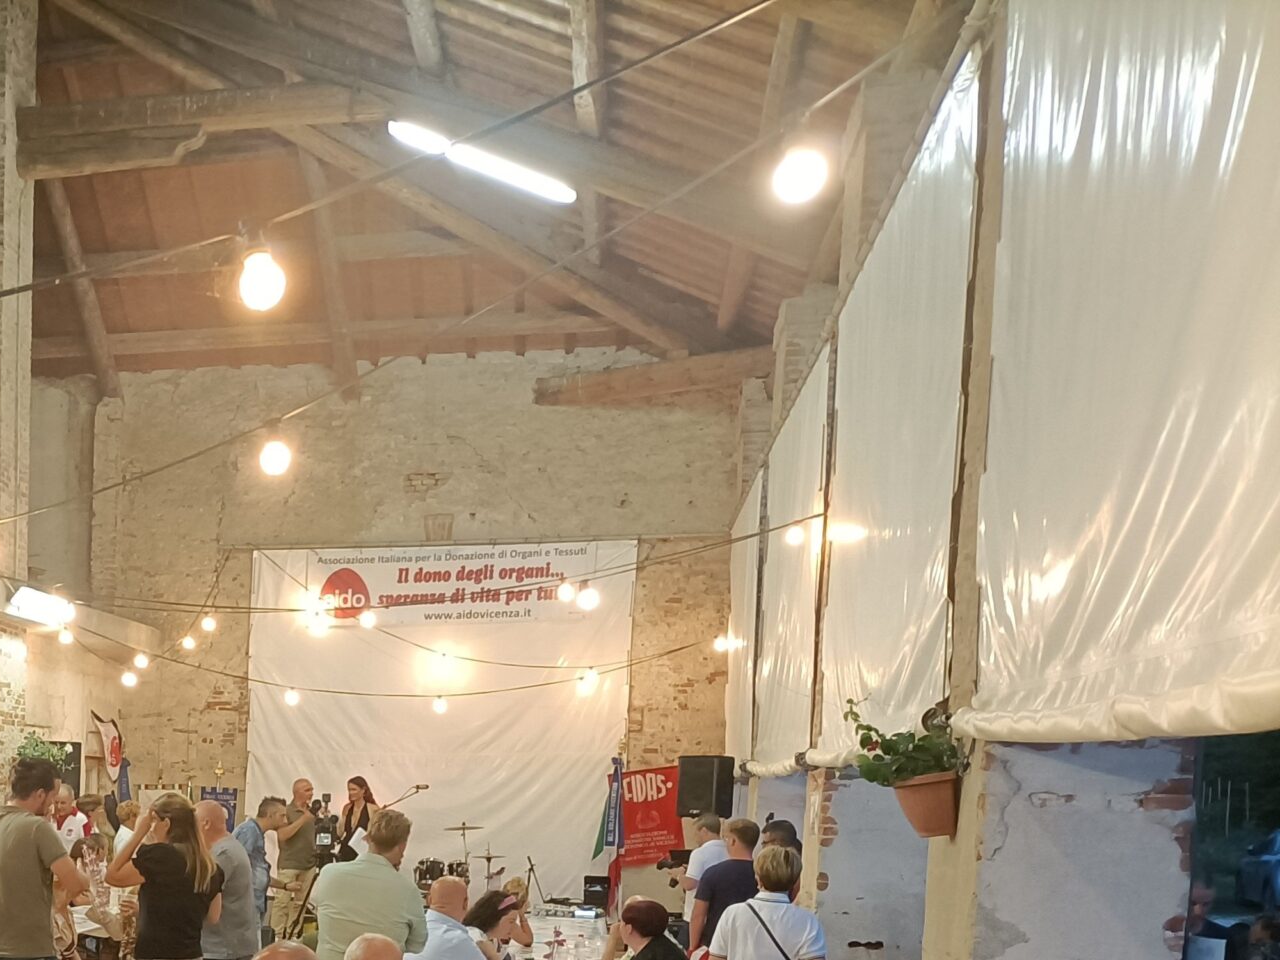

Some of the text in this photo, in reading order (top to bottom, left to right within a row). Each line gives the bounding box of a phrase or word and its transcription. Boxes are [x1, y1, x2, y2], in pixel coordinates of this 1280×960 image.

[317, 546, 587, 565] Associazione Italiana per la Donazione di Organi e Tessuti
[397, 567, 409, 583] Il
[413, 566, 451, 583] dono
[455, 563, 494, 585] degli
[450, 587, 466, 604] di
[470, 587, 501, 603] vita
[504, 588, 532, 606] per
[424, 608, 531, 620] www.aidovicenza.it
